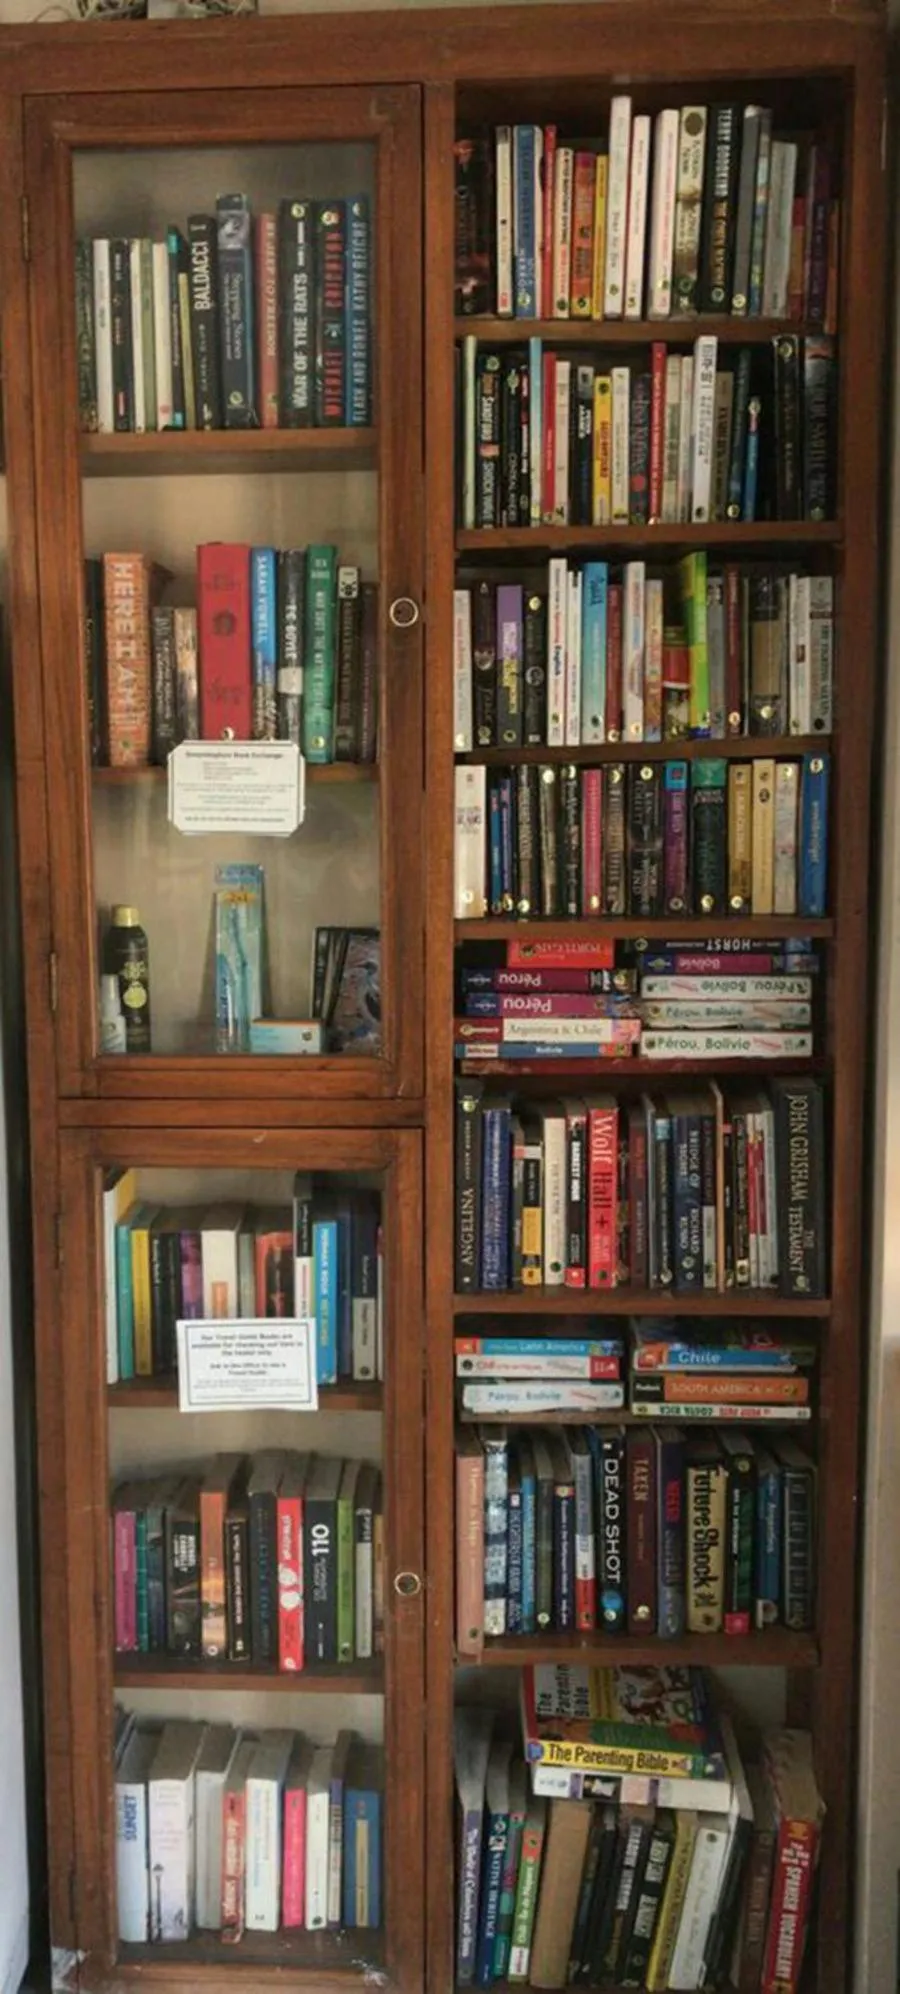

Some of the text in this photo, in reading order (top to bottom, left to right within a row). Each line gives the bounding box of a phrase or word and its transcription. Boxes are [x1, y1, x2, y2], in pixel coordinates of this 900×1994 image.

[191, 241, 212, 310] BALDACCI
[290, 273, 307, 314] RATS
[291, 316, 307, 347] THE
[324, 232, 341, 416] MICHAEL CRICHTON
[292, 350, 307, 372] OF
[291, 374, 308, 408] WAR
[256, 556, 268, 595] SARAH
[256, 597, 268, 644] VOWELL
[706, 938, 752, 952] HORST
[498, 973, 543, 987] Pérou
[503, 997, 553, 1014] Pérou
[657, 1037, 752, 1051] Pérou, Bolivie
[591, 1115, 613, 1209] Wolf Hall
[786, 1094, 809, 1202] JOHN GRISHAM
[570, 1141, 581, 1202] DARKEST HOUR
[461, 1187, 474, 1266] ANGELINA
[787, 1206, 804, 1272] TESTAMENT
[803, 1229, 814, 1249] THE
[677, 1350, 721, 1364] Chile
[671, 1384, 762, 1395] SOUTH AMERICA
[633, 1457, 650, 1502] TAKEN
[311, 1524, 330, 1557] 110
[603, 1458, 621, 1584] DEAD SHOT
[693, 1467, 720, 1589] Future Shock
[555, 1663, 571, 1716] Parentin
[547, 1743, 670, 1773] The Parenting Bible
[123, 1794, 138, 1842] SUNSET
[484, 1852, 502, 1938] NATIVE HERITAGE
[782, 1866, 803, 1910] SPANISH
[775, 1912, 797, 1979] VOCABULARY
